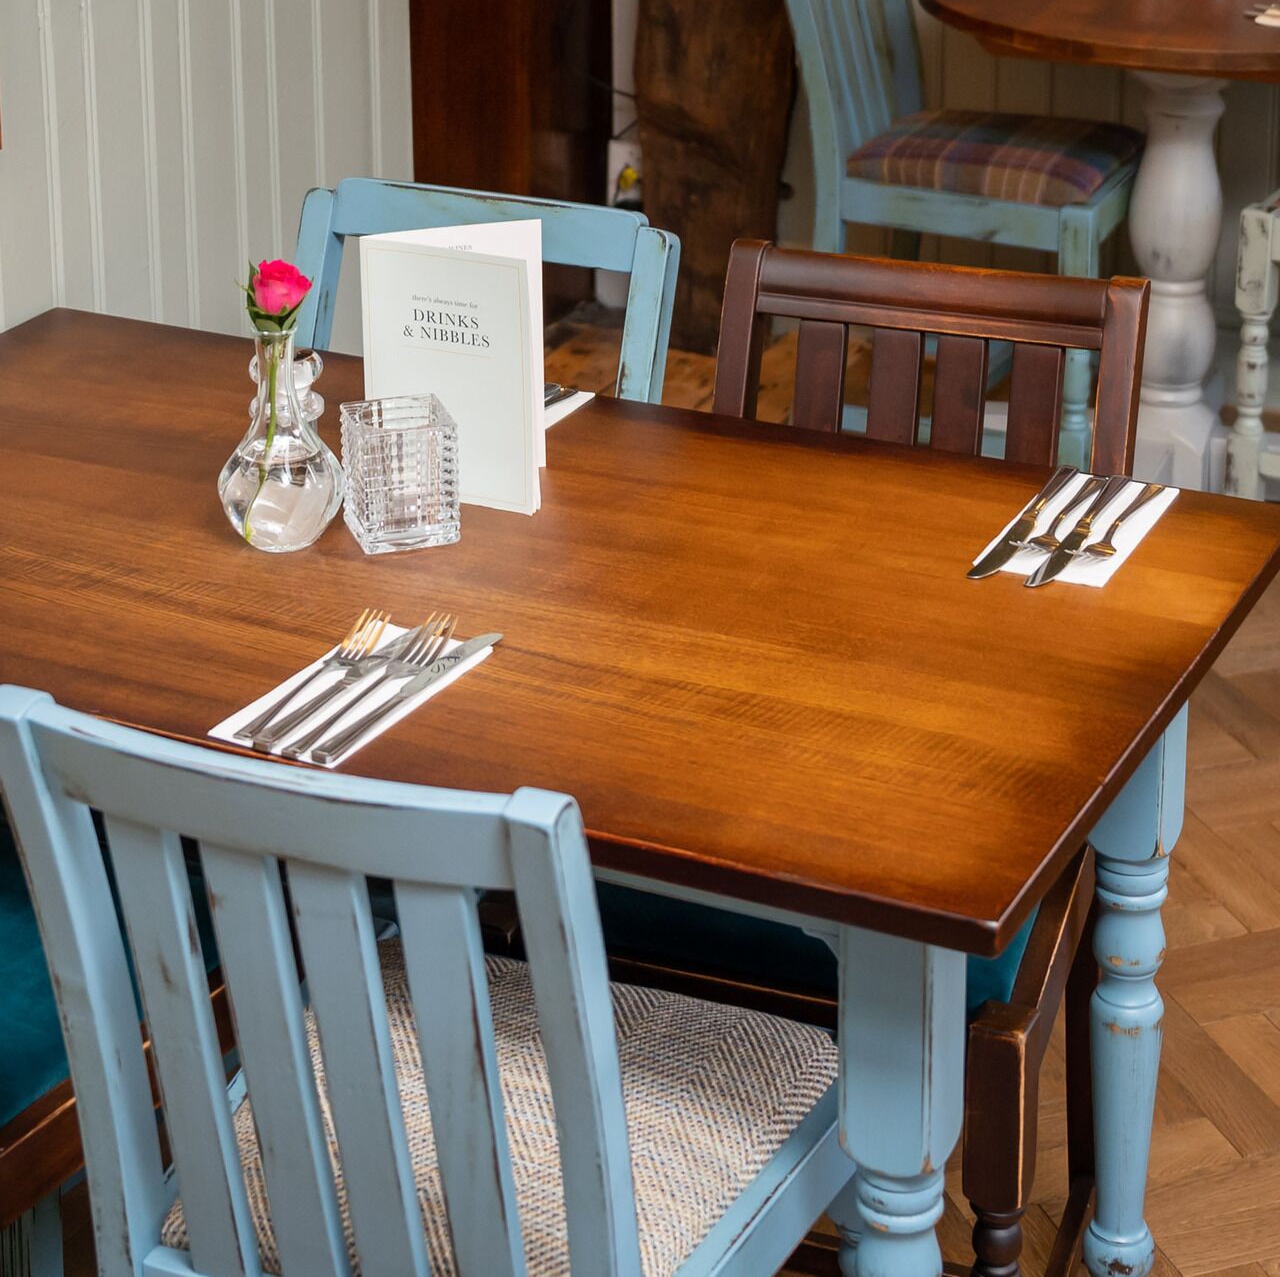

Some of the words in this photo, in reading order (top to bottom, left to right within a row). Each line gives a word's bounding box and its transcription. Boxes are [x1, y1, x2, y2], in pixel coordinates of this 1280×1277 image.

[412, 294, 432, 303] there's
[433, 297, 453, 306] always
[413, 308, 479, 330] DRINKS
[403, 324, 415, 338] &
[420, 326, 490, 348] NIBBLES
